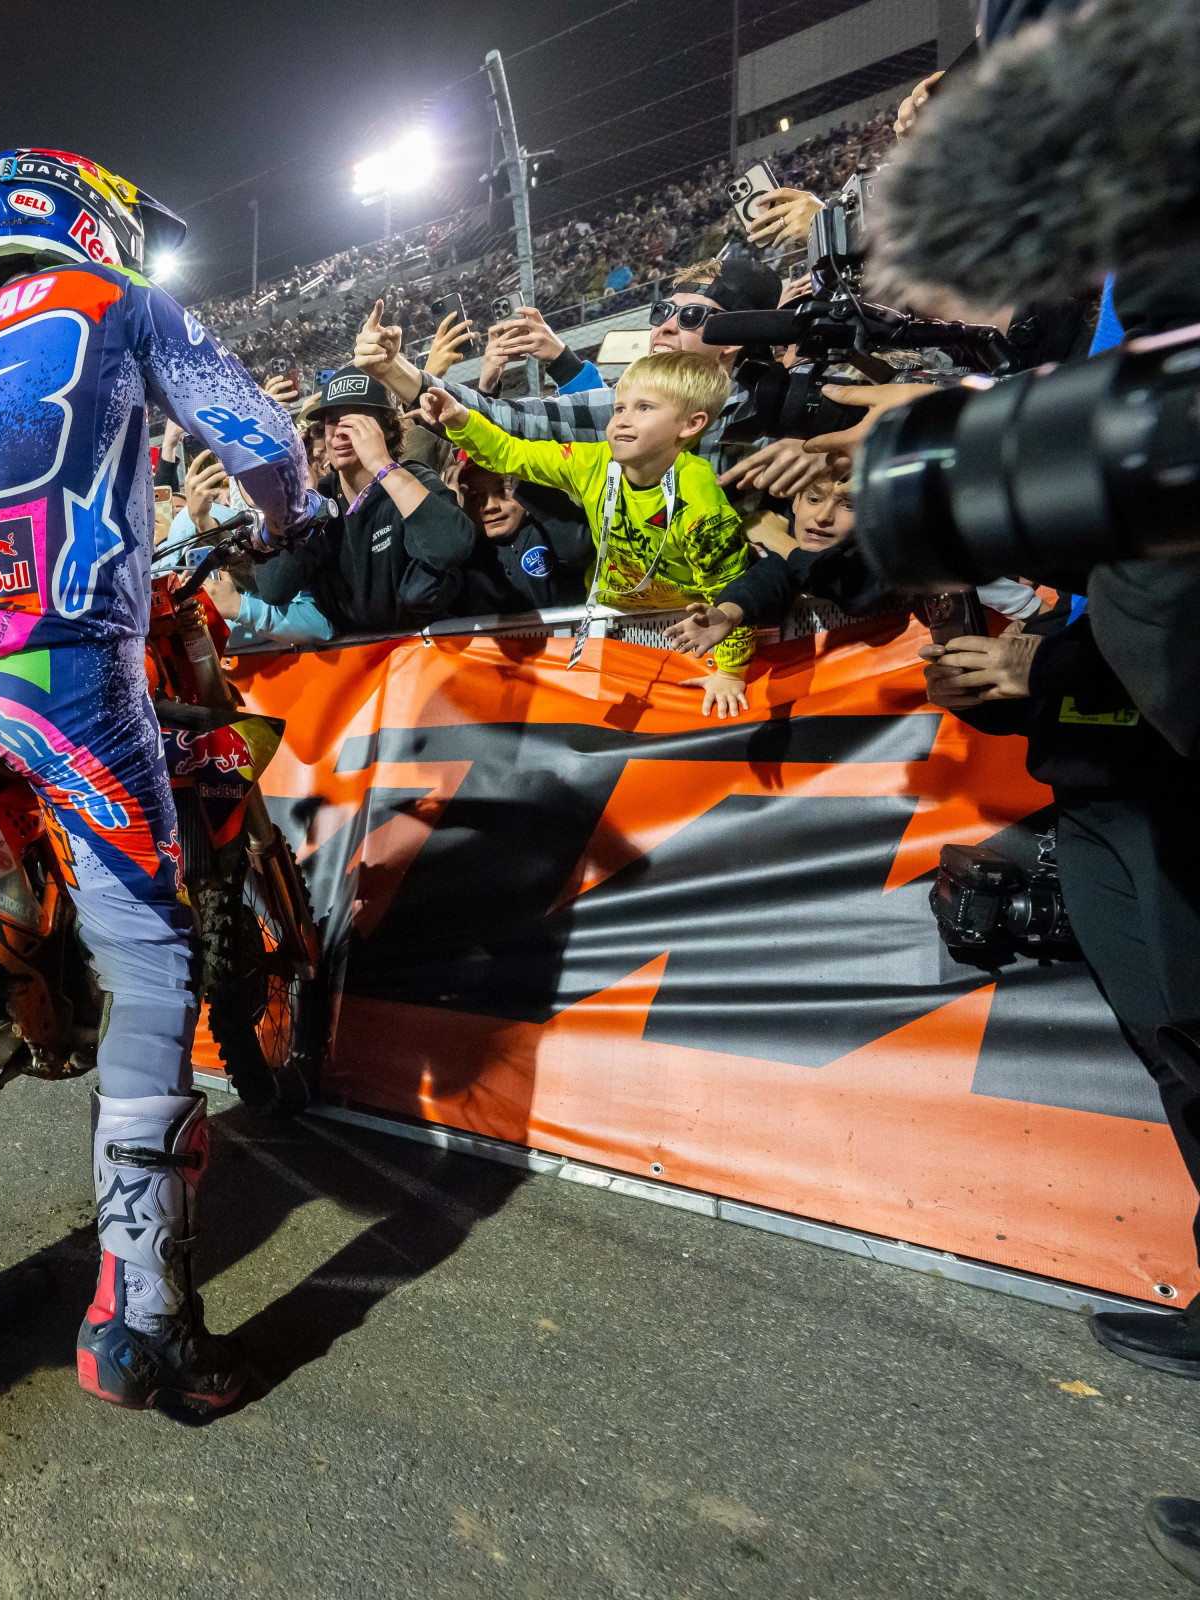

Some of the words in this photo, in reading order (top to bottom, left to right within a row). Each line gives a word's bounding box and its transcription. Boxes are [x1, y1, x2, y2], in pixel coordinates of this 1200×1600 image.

[21, 162, 116, 218] OAKLEY
[14, 193, 48, 213] BELL
[200, 783, 223, 797] Red
[223, 784, 244, 798] Bull
